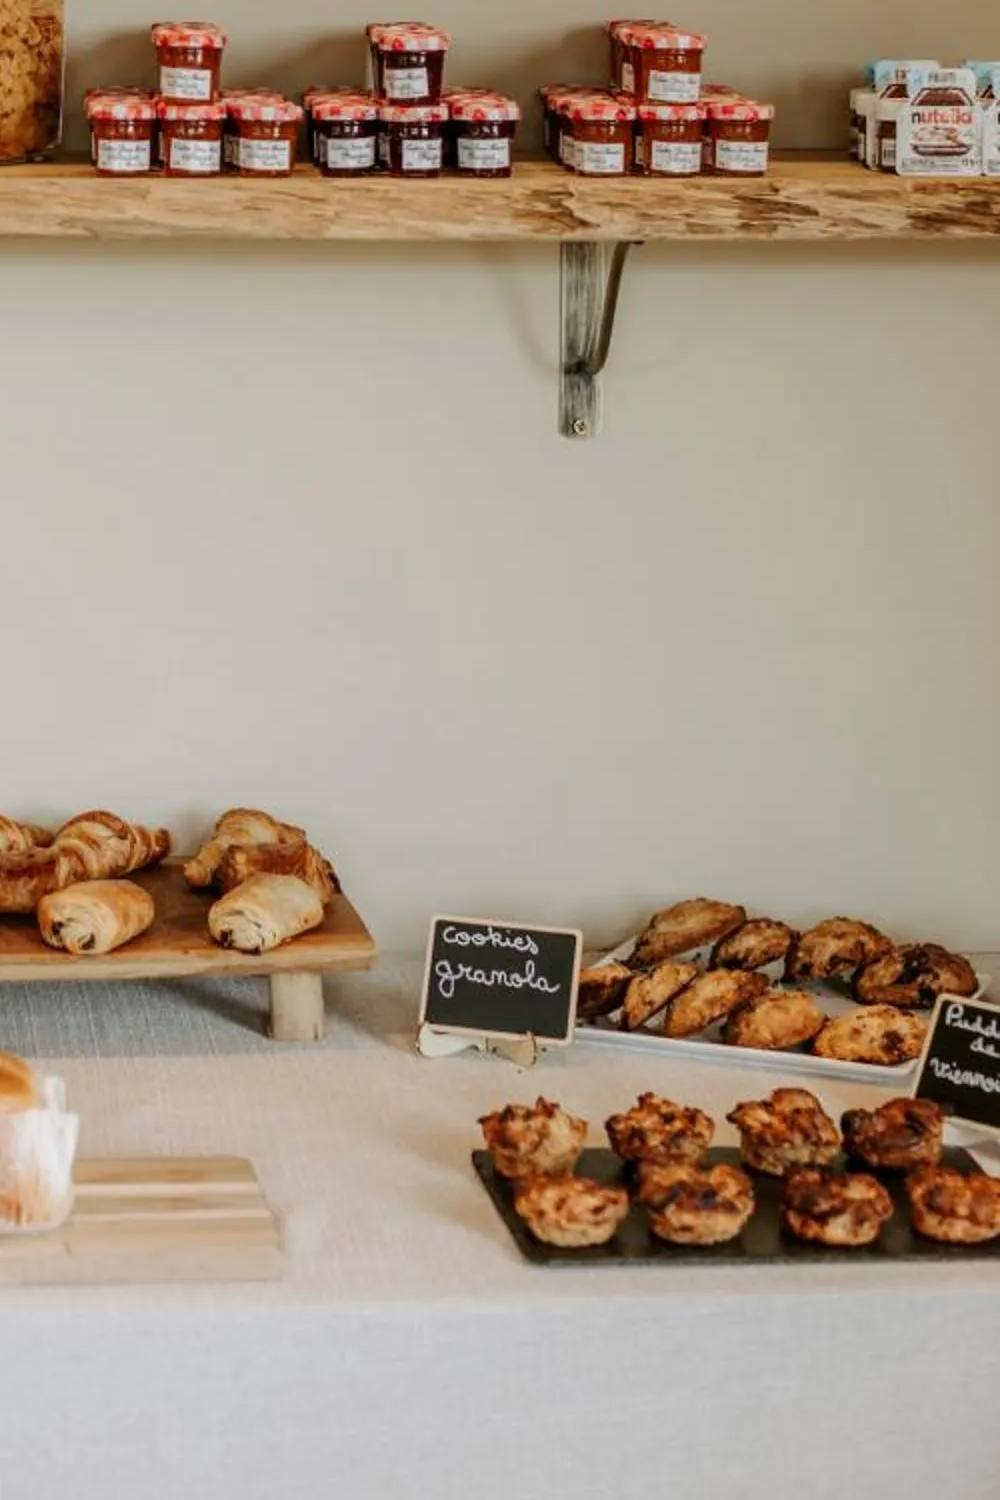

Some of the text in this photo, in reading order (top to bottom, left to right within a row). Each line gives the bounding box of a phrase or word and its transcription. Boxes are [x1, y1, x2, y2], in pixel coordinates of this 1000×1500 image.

[911, 107, 973, 124] nutella
[435, 960, 561, 998] granola
[945, 1003, 1000, 1039] Pudd
